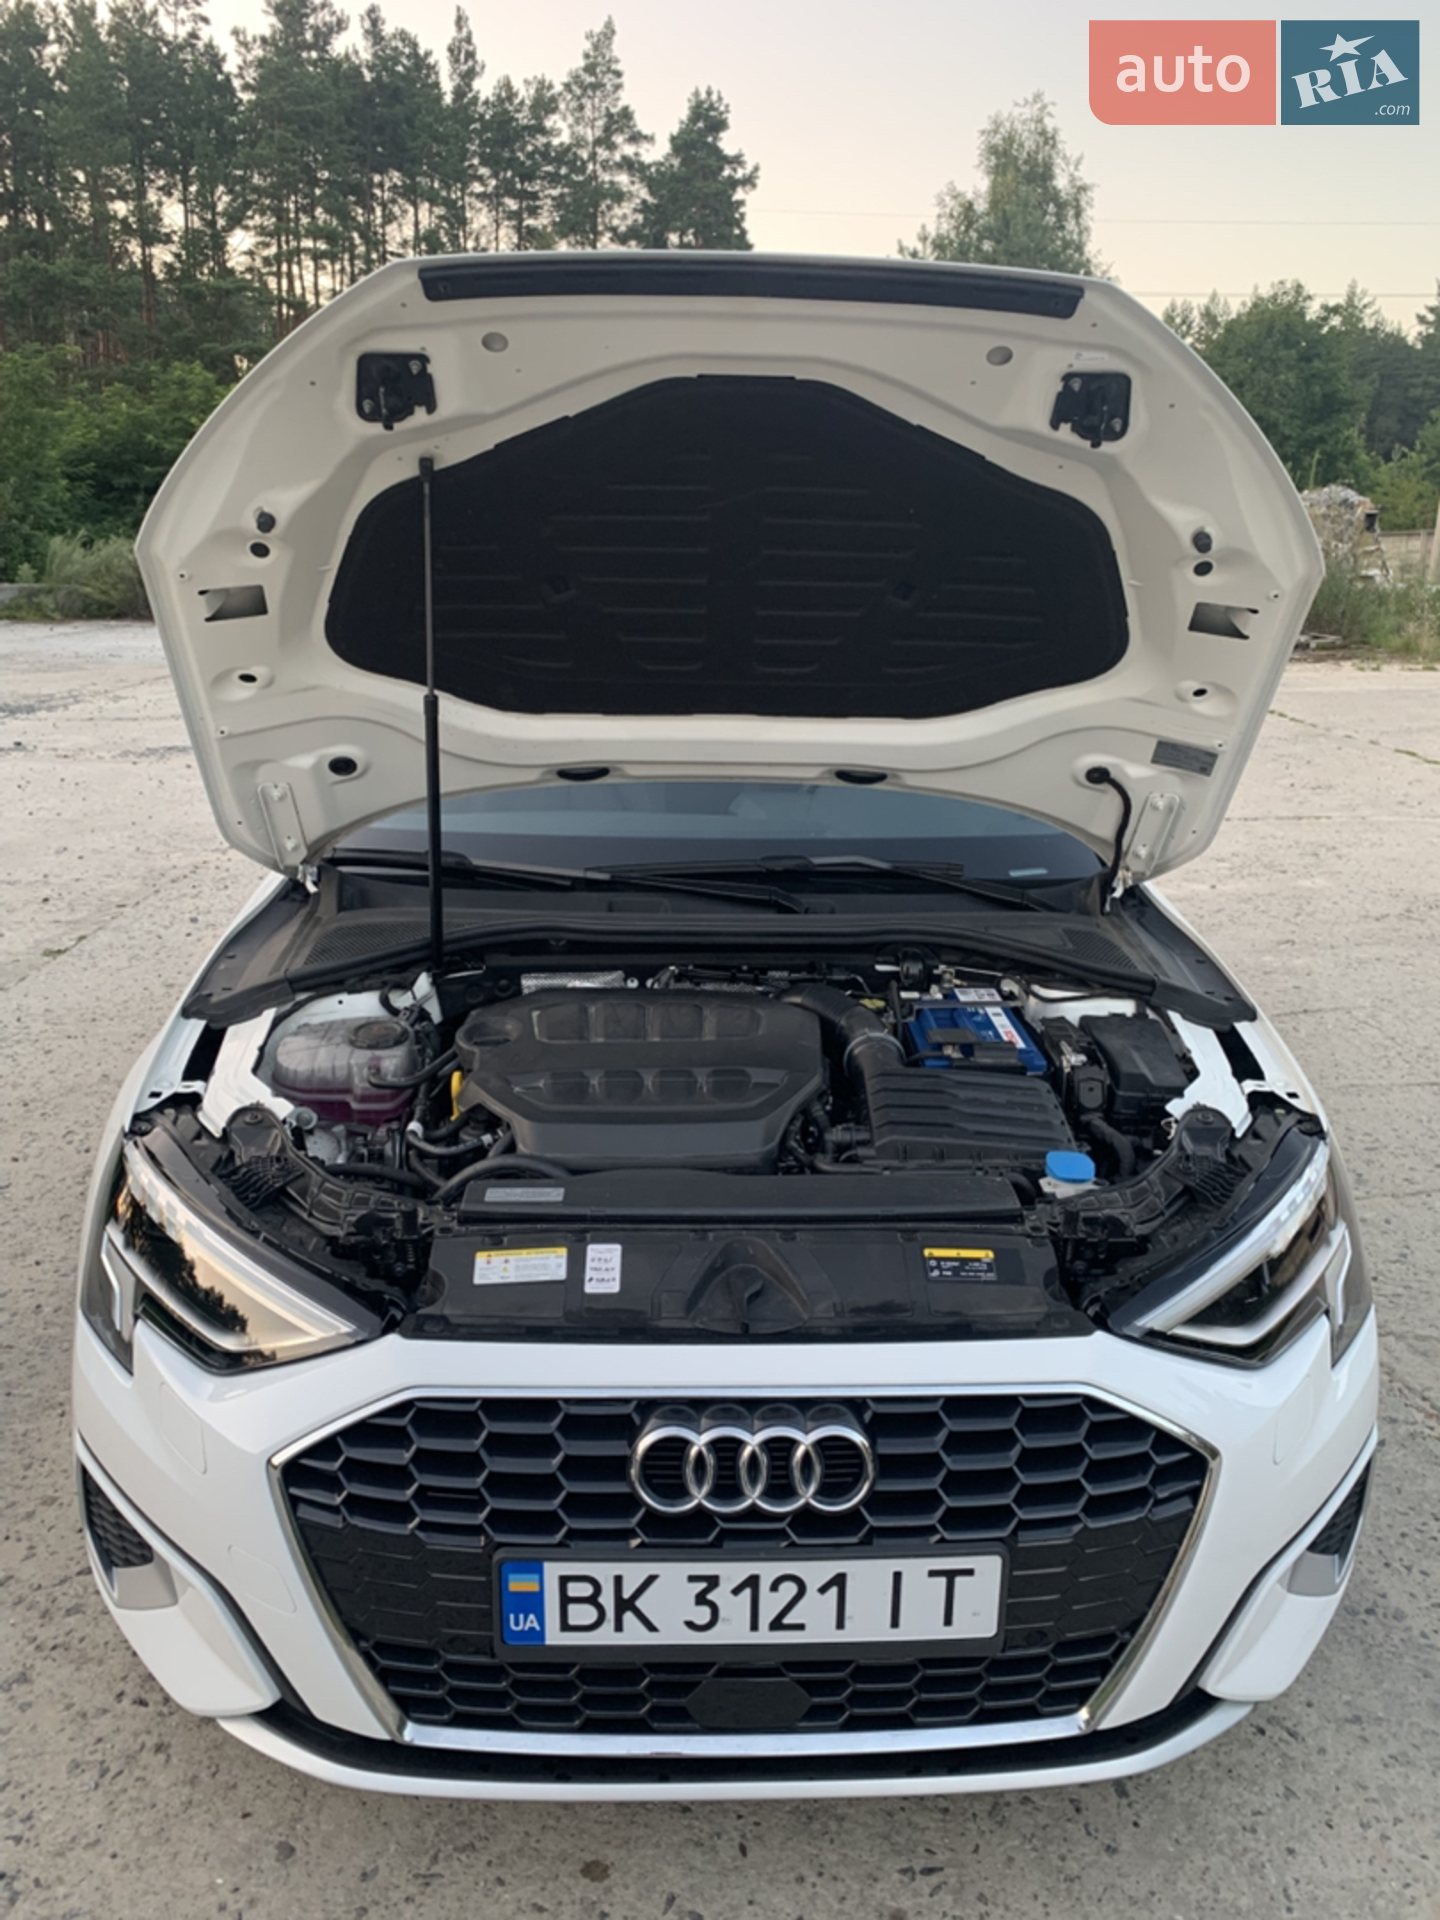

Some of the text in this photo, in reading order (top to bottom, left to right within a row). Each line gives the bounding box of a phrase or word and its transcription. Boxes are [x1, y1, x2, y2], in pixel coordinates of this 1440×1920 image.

[557, 1568, 975, 1633] BK 3121 IT
[508, 1613, 540, 1631] UA
